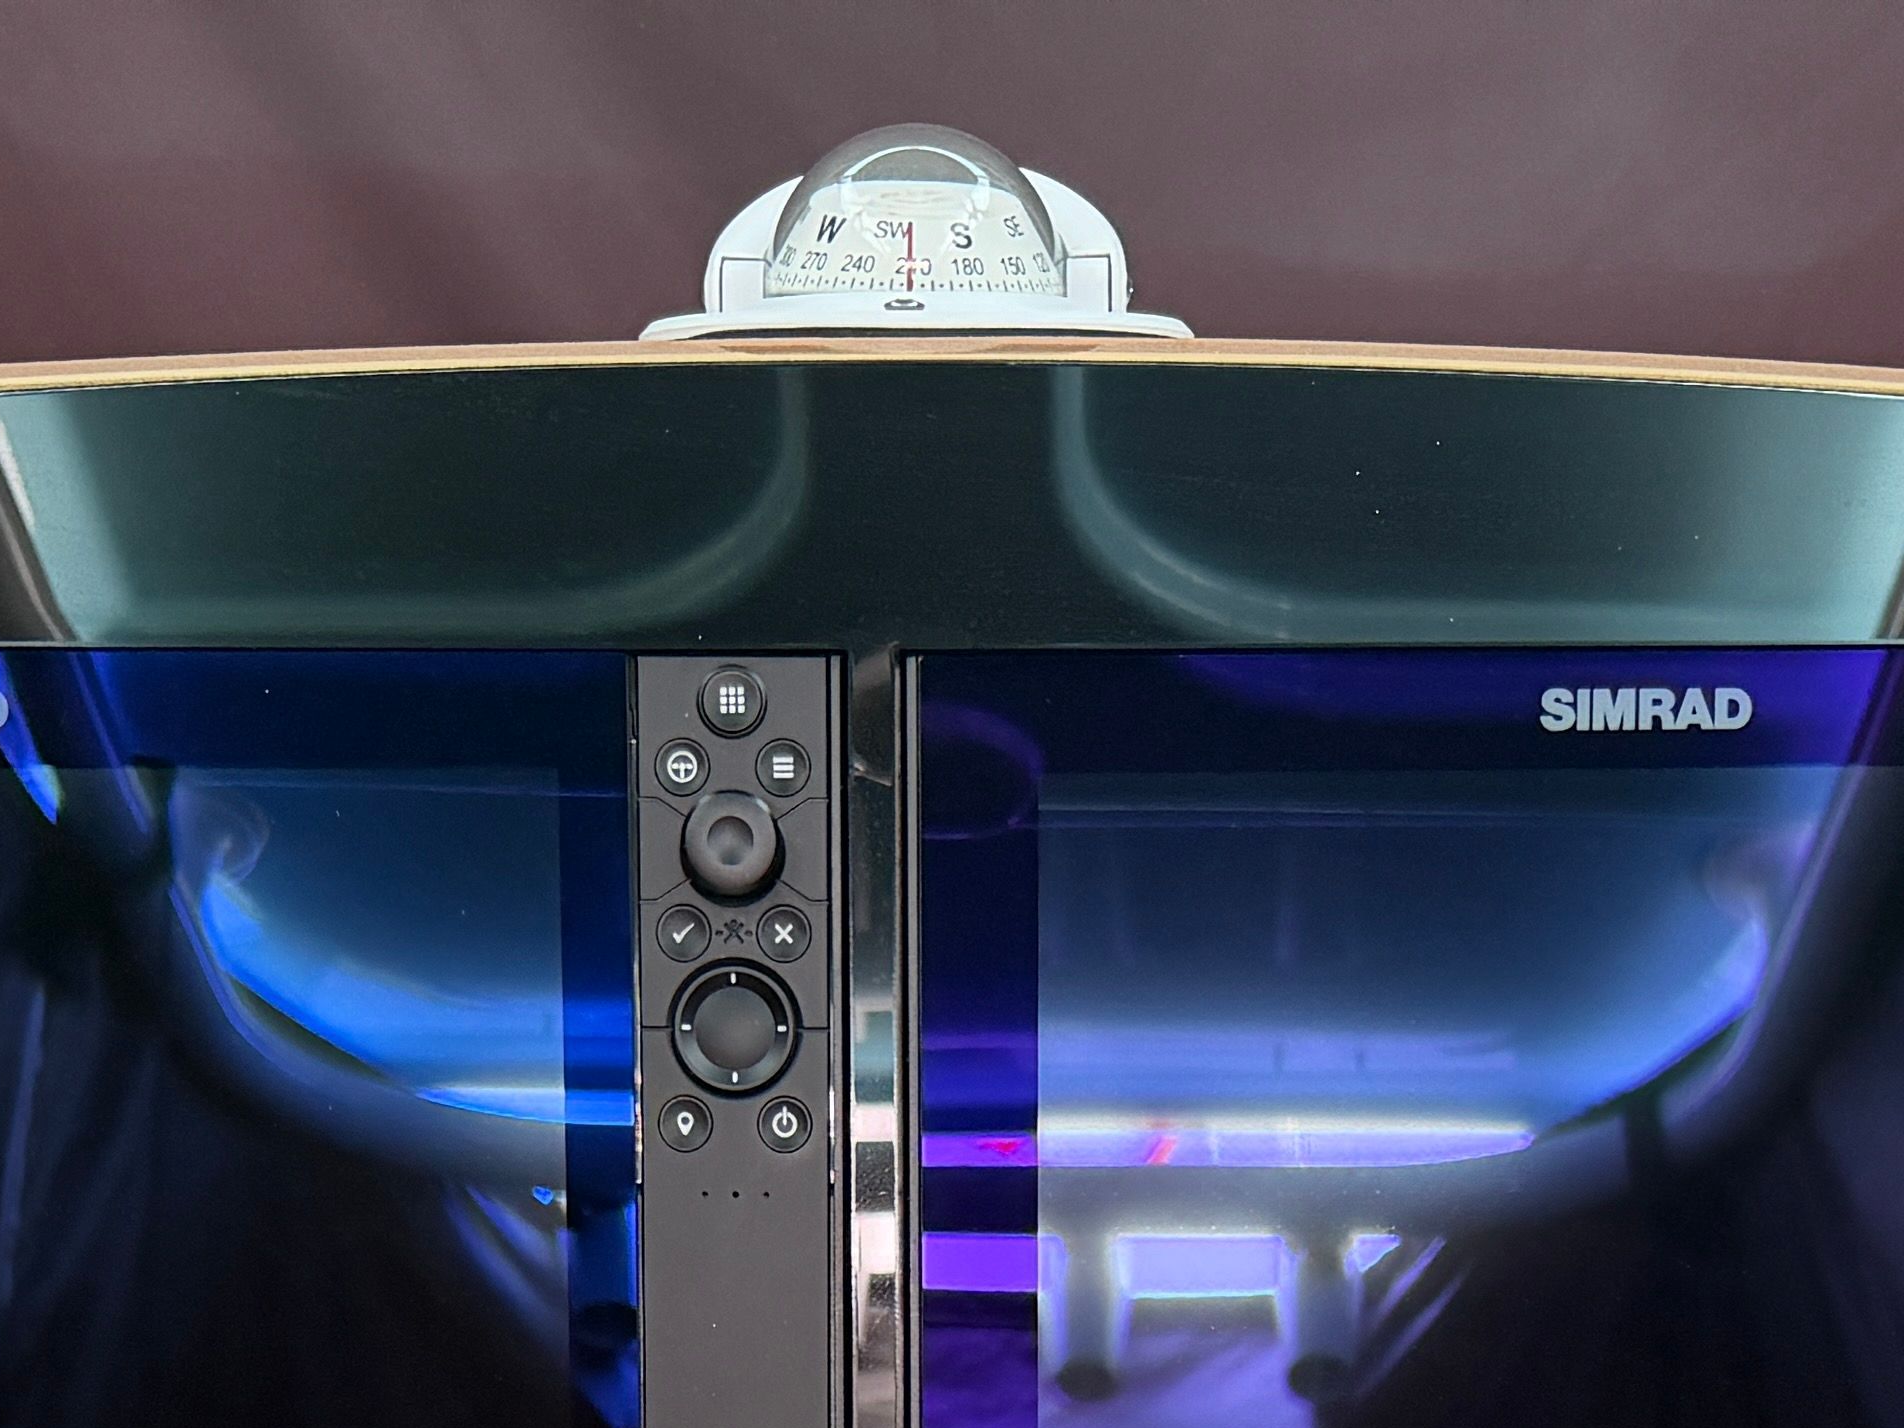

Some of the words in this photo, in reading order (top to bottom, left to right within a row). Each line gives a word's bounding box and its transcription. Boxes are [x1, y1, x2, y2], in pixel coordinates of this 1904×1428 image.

[816, 214, 847, 244] W
[873, 219, 911, 239] SW
[950, 222, 972, 249] S
[1003, 215, 1024, 238] SE
[800, 251, 828, 271] 270
[840, 254, 875, 273] 240
[895, 257, 932, 276] 20
[951, 257, 984, 276] 180
[1000, 257, 1026, 276] 150
[1539, 687, 1753, 732] SIMRAD
